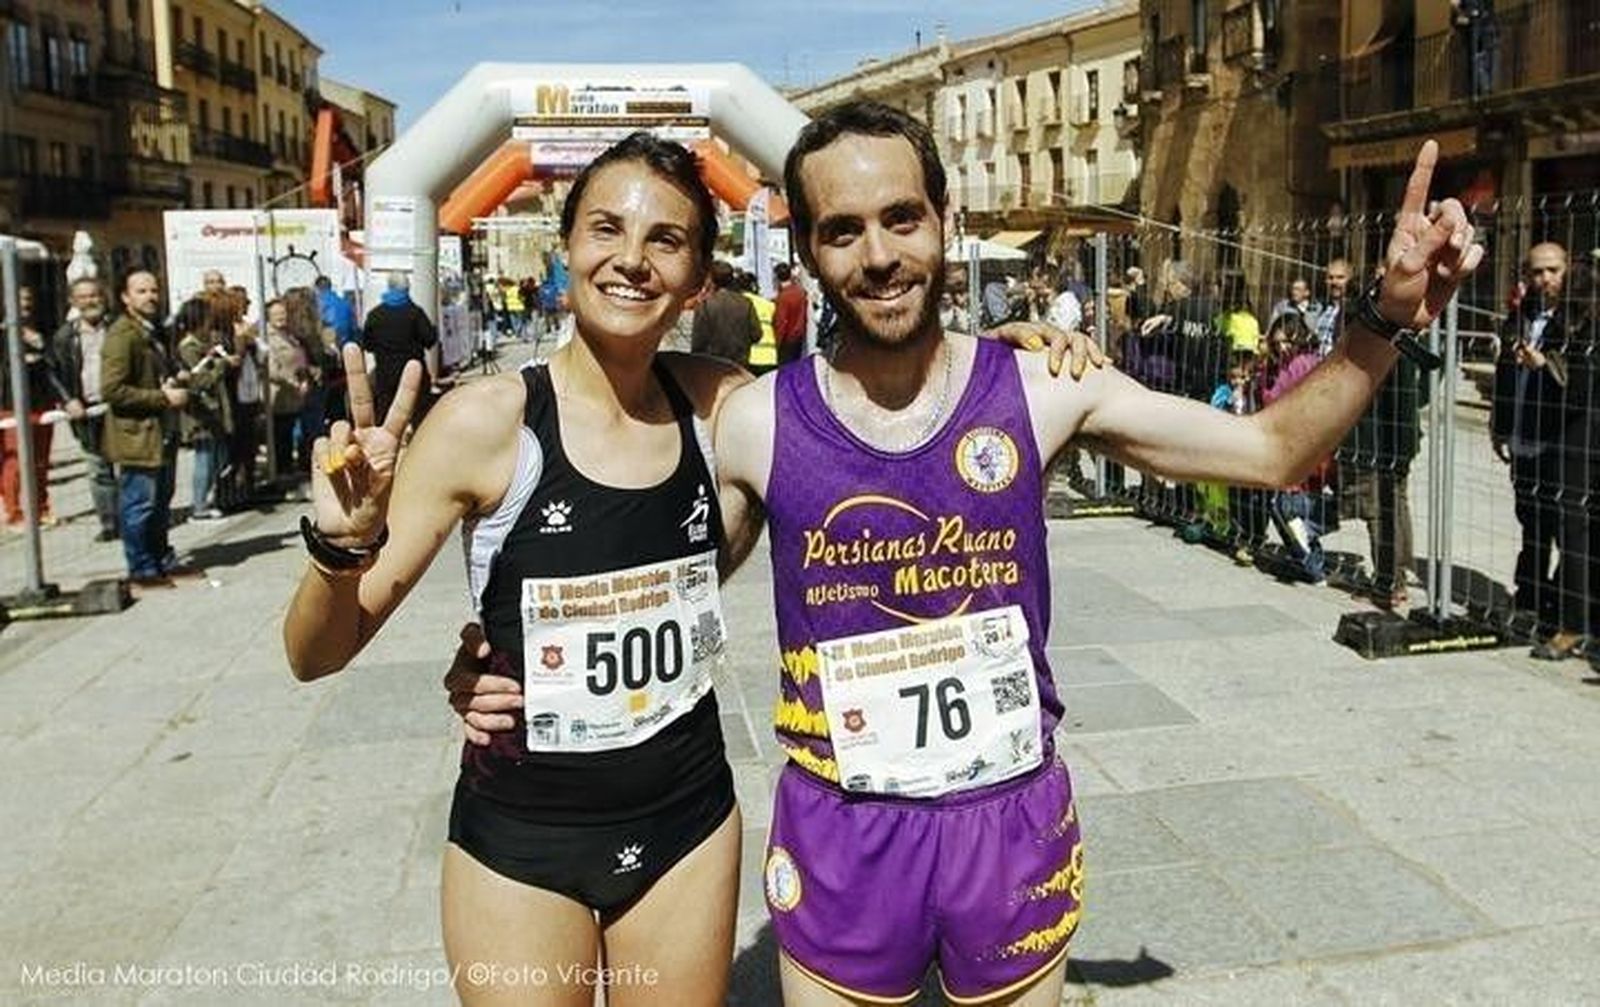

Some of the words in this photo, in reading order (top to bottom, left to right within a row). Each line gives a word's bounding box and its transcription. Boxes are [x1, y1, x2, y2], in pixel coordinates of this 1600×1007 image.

[803, 528, 926, 569] Persianas
[931, 515, 1016, 555] Ruano
[559, 579, 610, 601] Media
[805, 583, 879, 605] Atletismo
[895, 556, 1019, 595] Macotera
[539, 605, 559, 619] de
[562, 599, 617, 618] Ciudad
[618, 590, 670, 613] Rodrigo
[586, 619, 684, 697] 500
[834, 665, 854, 681] de
[855, 657, 908, 678] Ciudad
[909, 644, 966, 669] Rodrigo
[851, 637, 898, 658] Media
[898, 677, 972, 749] 76
